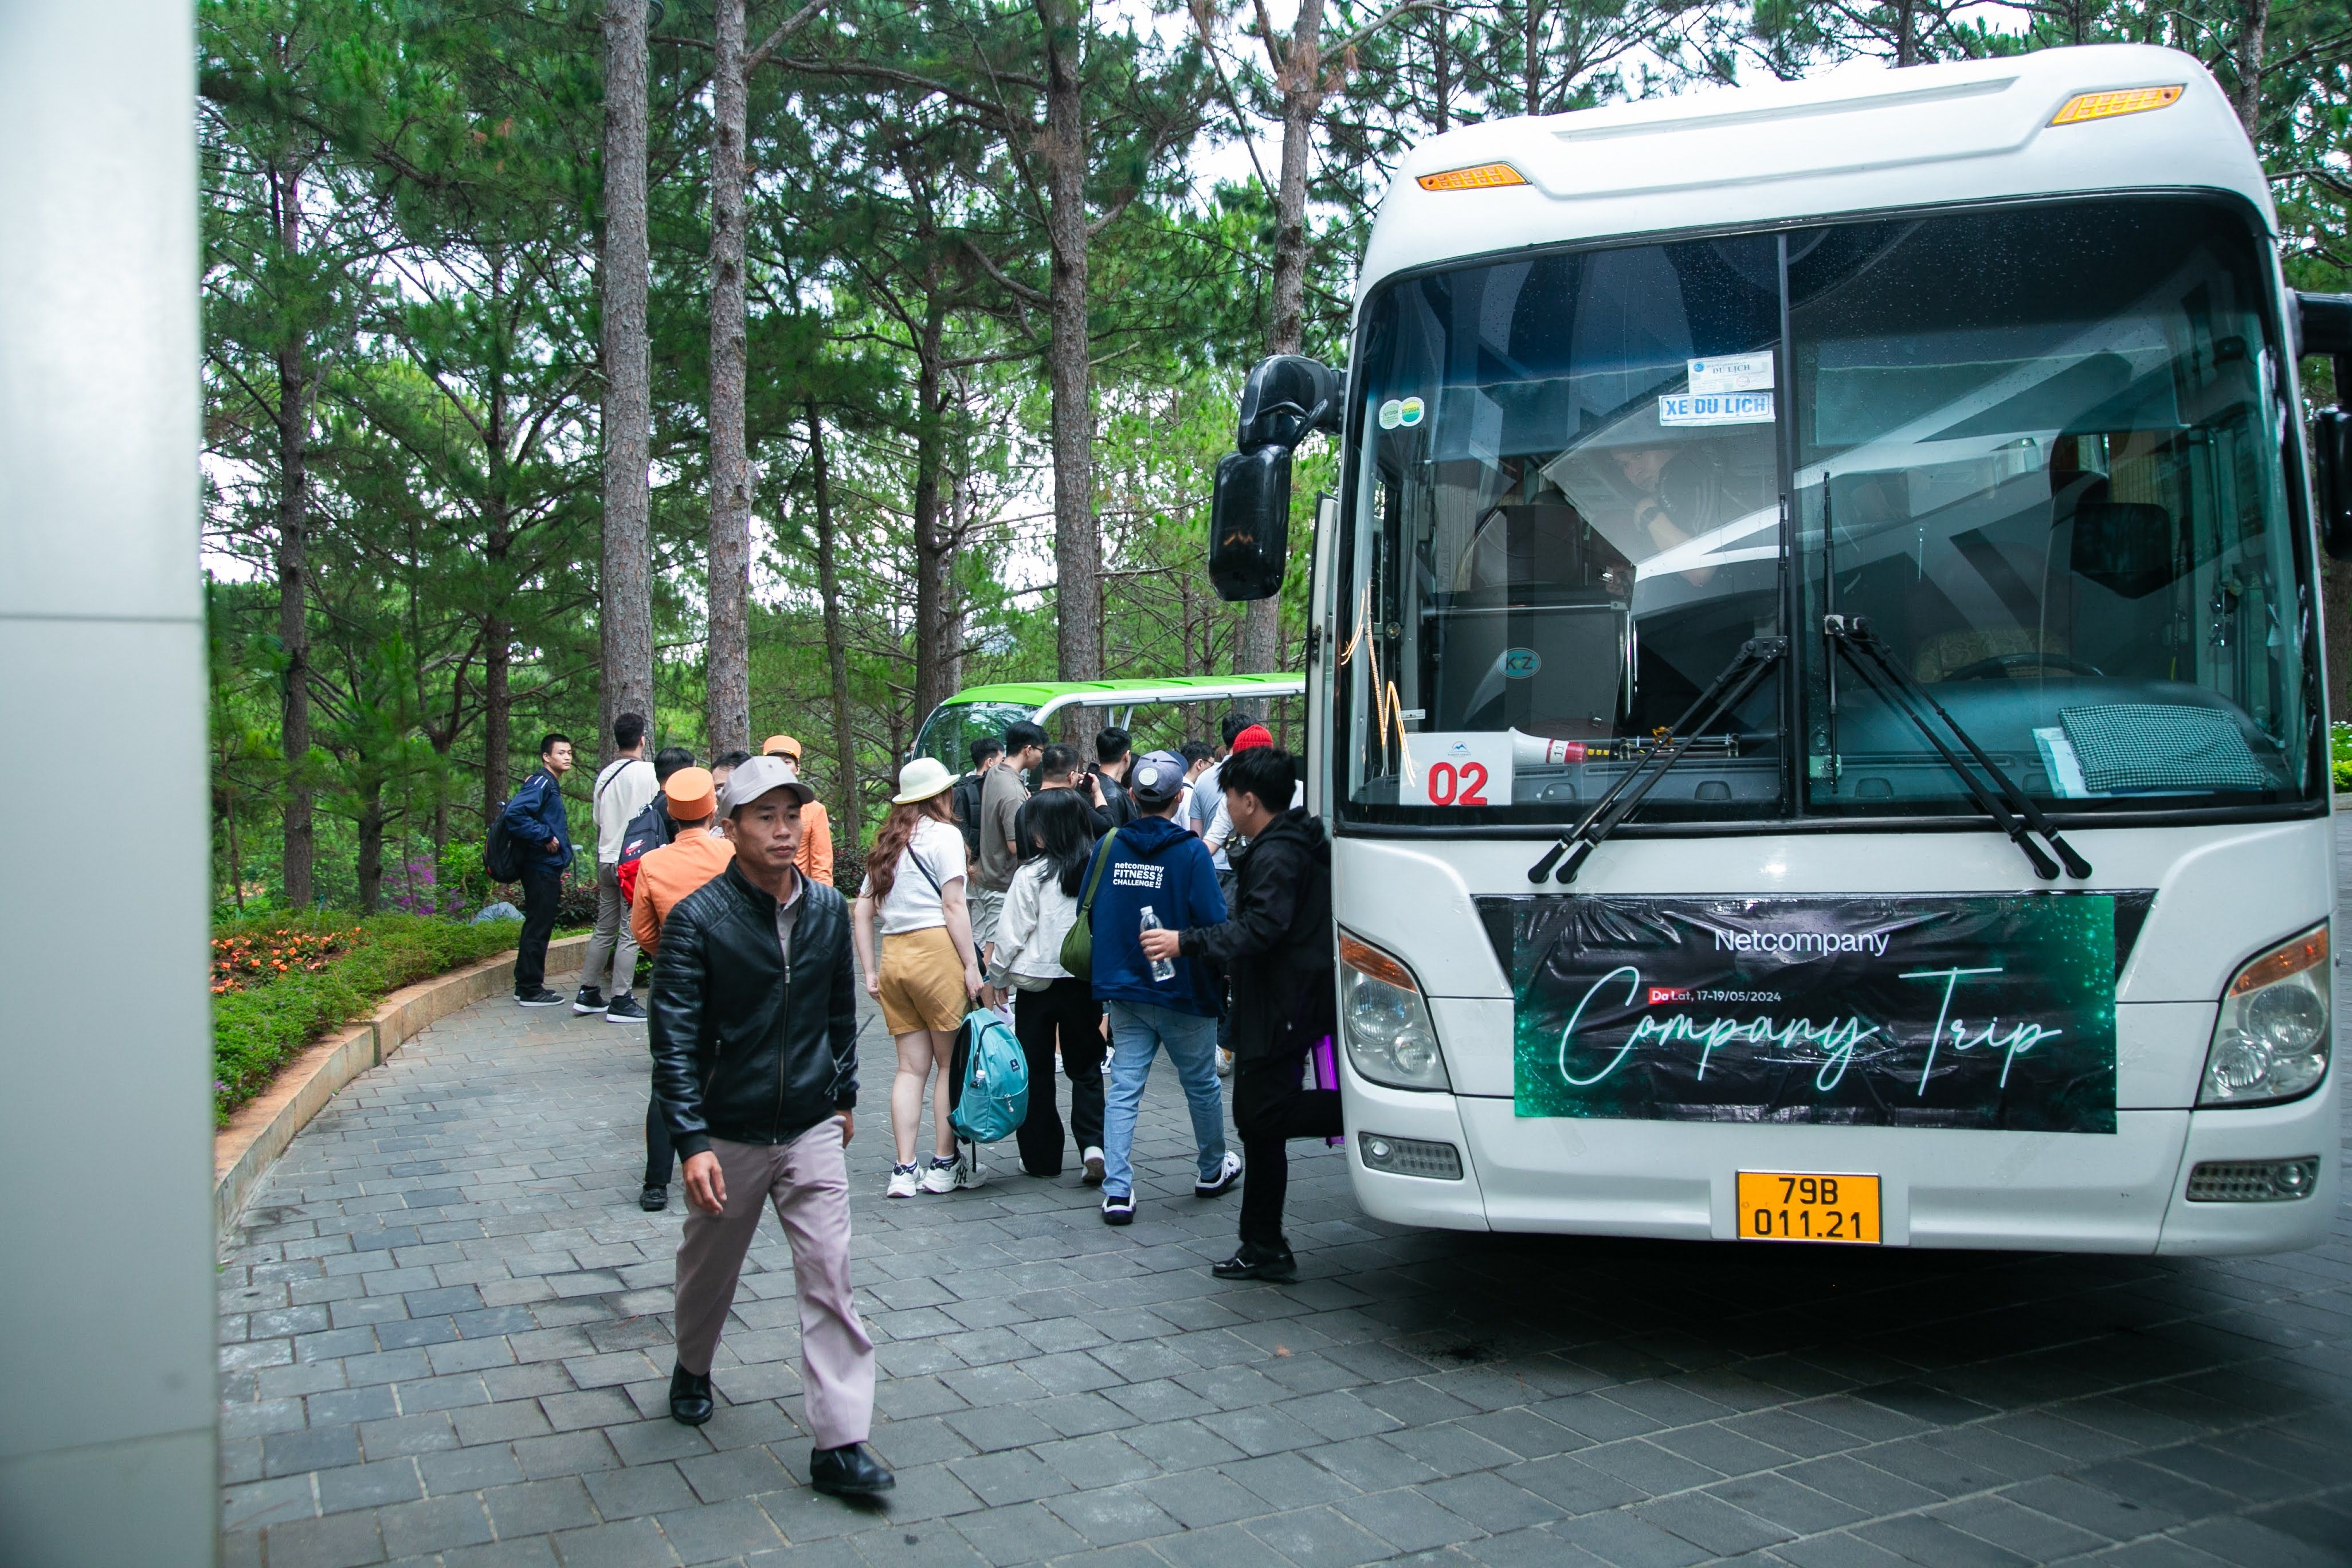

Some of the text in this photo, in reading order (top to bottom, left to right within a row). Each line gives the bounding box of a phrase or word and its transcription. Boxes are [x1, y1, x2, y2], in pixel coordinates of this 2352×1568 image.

[1666, 398, 1765, 416] XE DU LỊCH
[1428, 762, 1488, 806] 02
[1114, 869, 1155, 880] FITNESS
[1115, 862, 1164, 873] netcompany
[1112, 879, 1155, 888] CHALLENGE
[1155, 872, 1163, 889] 2021
[1715, 929, 1890, 957] Netcompany
[1651, 990, 1669, 1002] Da
[1697, 990, 1782, 1002] 17-19/05/2024
[1558, 966, 2063, 1097] Company Trip
[1778, 1177, 1839, 1205] 79B
[1754, 1209, 1861, 1238] 011.21
